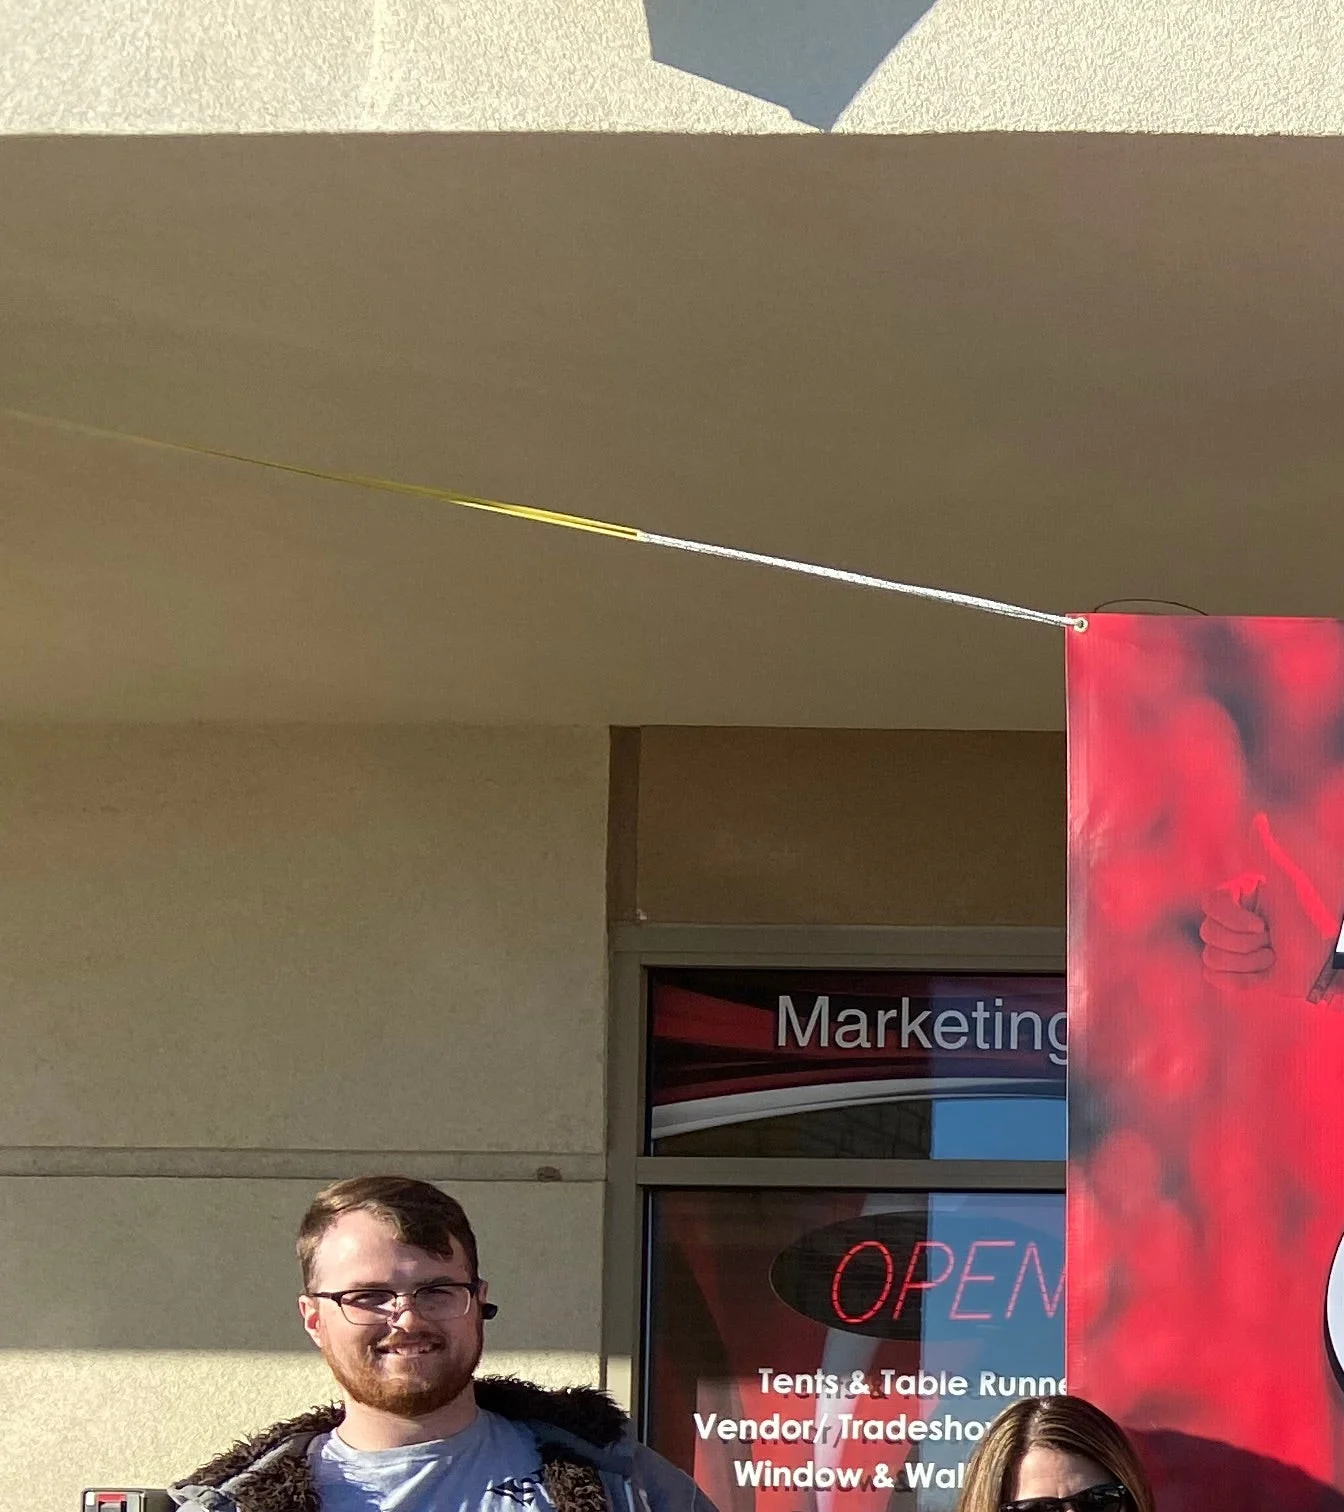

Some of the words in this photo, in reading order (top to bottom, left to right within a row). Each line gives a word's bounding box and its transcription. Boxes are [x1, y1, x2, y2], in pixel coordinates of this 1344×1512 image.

[777, 994, 1068, 1066] Marketing
[831, 1240, 1067, 1324] OPEN
[758, 1367, 839, 1395] Tents
[849, 1370, 870, 1396] &
[880, 1368, 968, 1396] Table
[693, 1413, 825, 1444] Vendor/
[838, 1414, 992, 1441] Tradesho
[734, 1460, 863, 1489] Window
[872, 1463, 895, 1489] &
